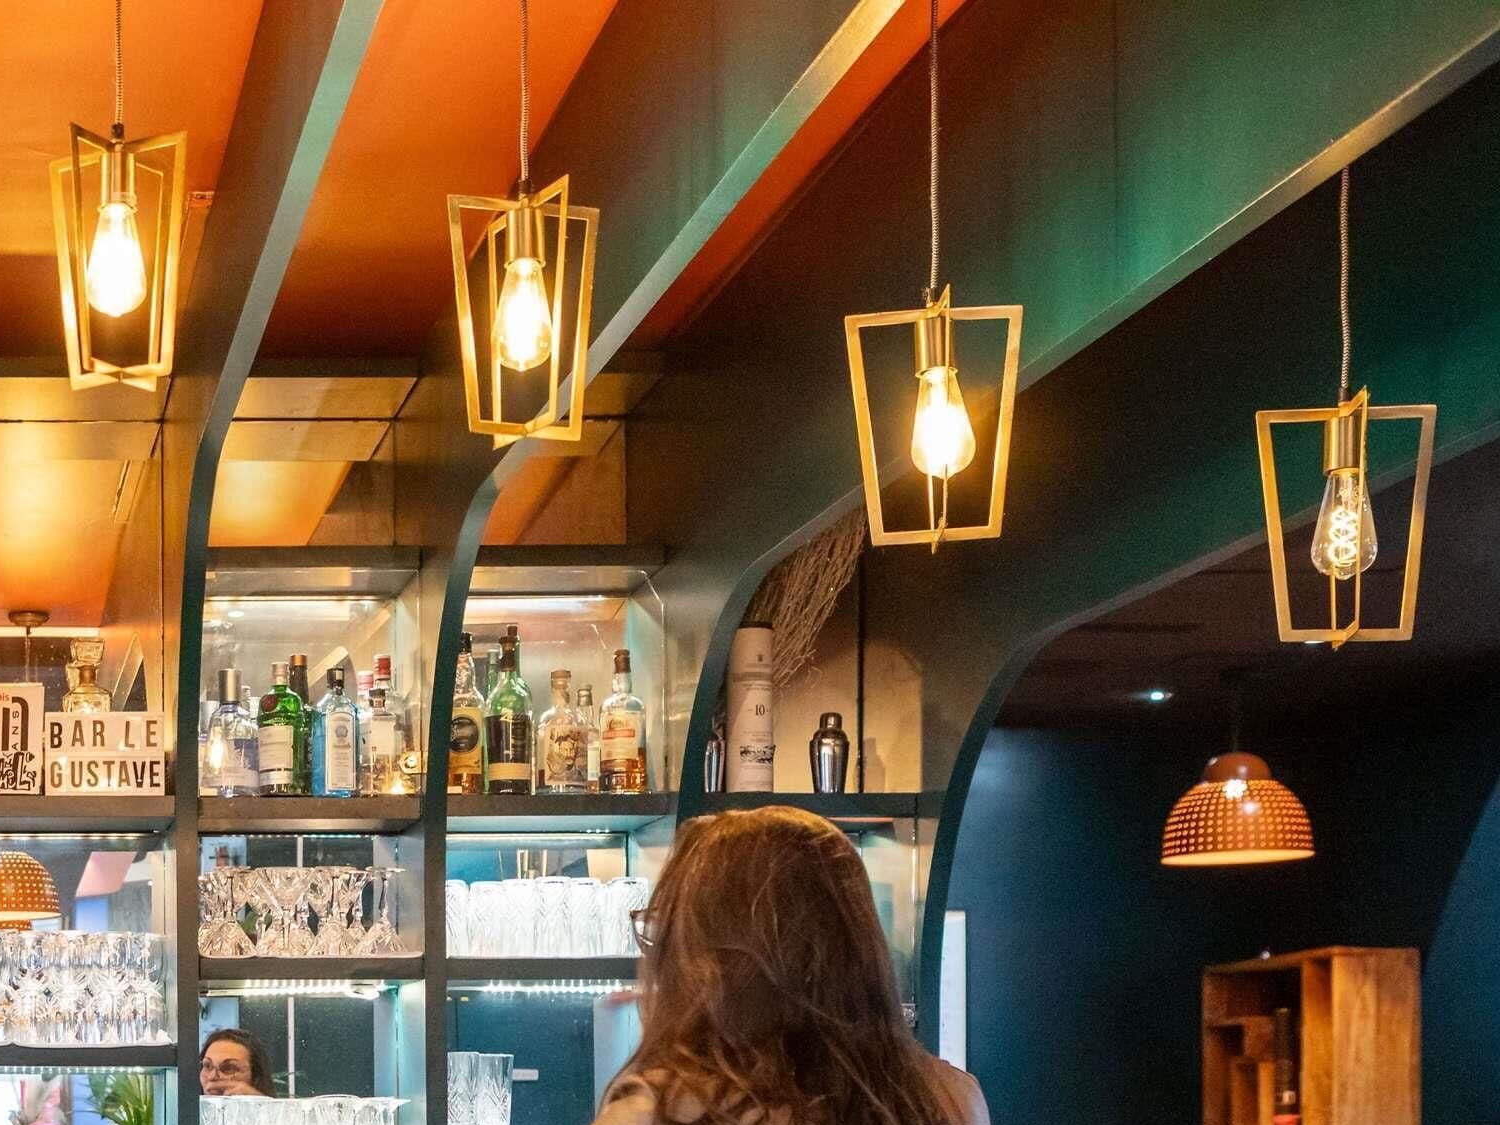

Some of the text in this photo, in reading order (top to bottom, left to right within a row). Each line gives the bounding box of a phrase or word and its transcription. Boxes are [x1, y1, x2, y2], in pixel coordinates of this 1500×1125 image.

[755, 704, 766, 716] 10
[11, 710, 20, 751] ANS
[50, 720, 158, 748] BAR LE
[50, 760, 161, 788] GUSTAVE
